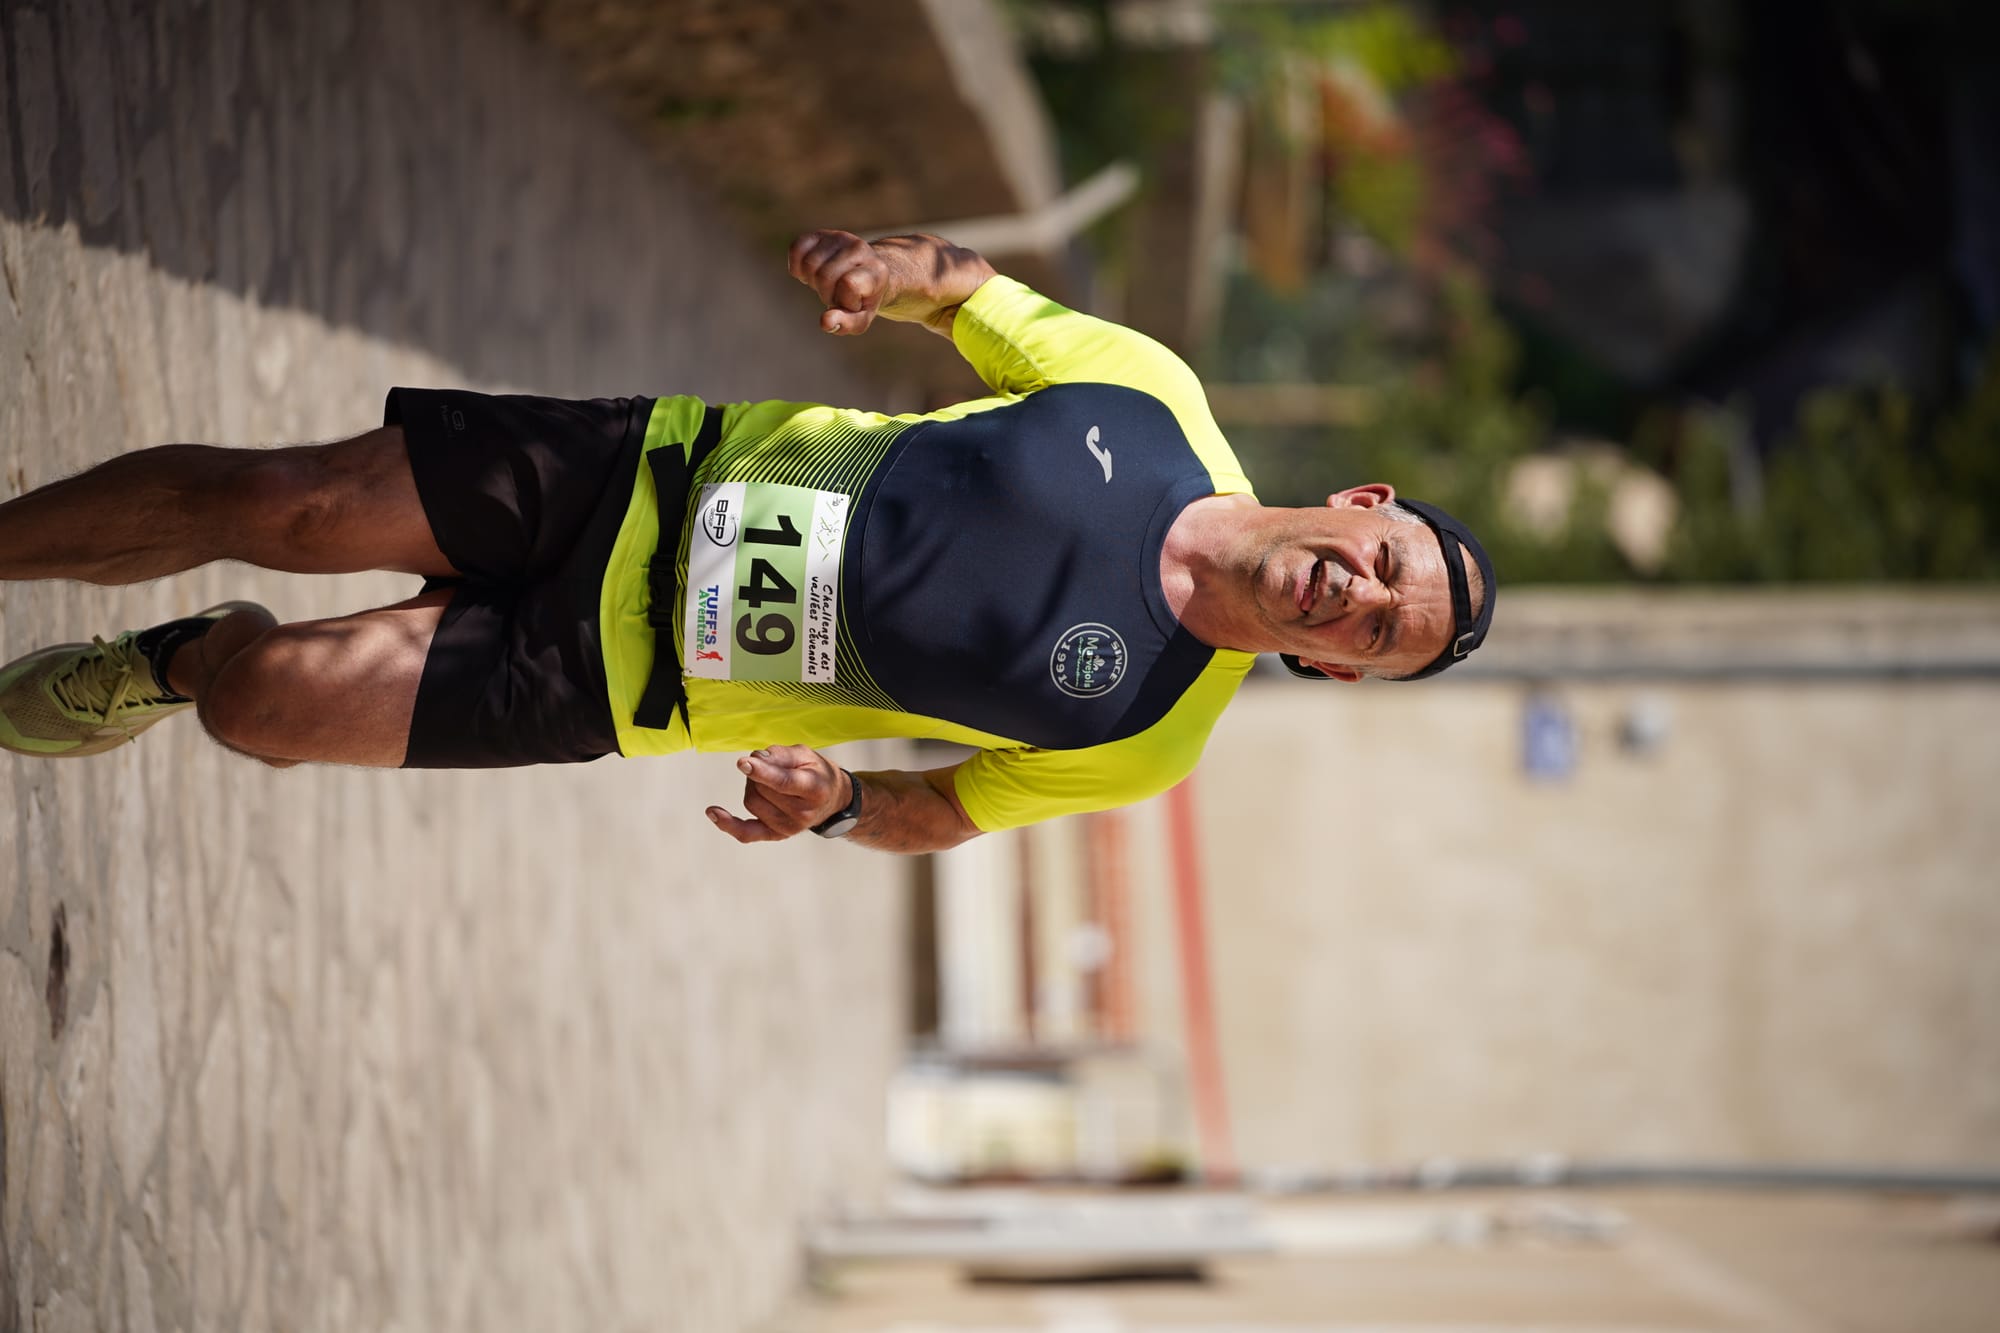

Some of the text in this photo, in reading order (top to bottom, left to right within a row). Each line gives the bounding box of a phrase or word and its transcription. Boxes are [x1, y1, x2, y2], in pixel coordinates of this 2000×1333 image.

[713, 500, 728, 540] BFP
[704, 585, 719, 645] TUFF'S
[736, 514, 803, 656] 149
[696, 589, 709, 650] Aventure
[808, 576, 819, 676] vallées cévenoles
[818, 584, 833, 671] Challenge des
[1056, 641, 1071, 684] 1991
[1082, 637, 1099, 688] Marvejols
[1109, 641, 1122, 682] SINCE
